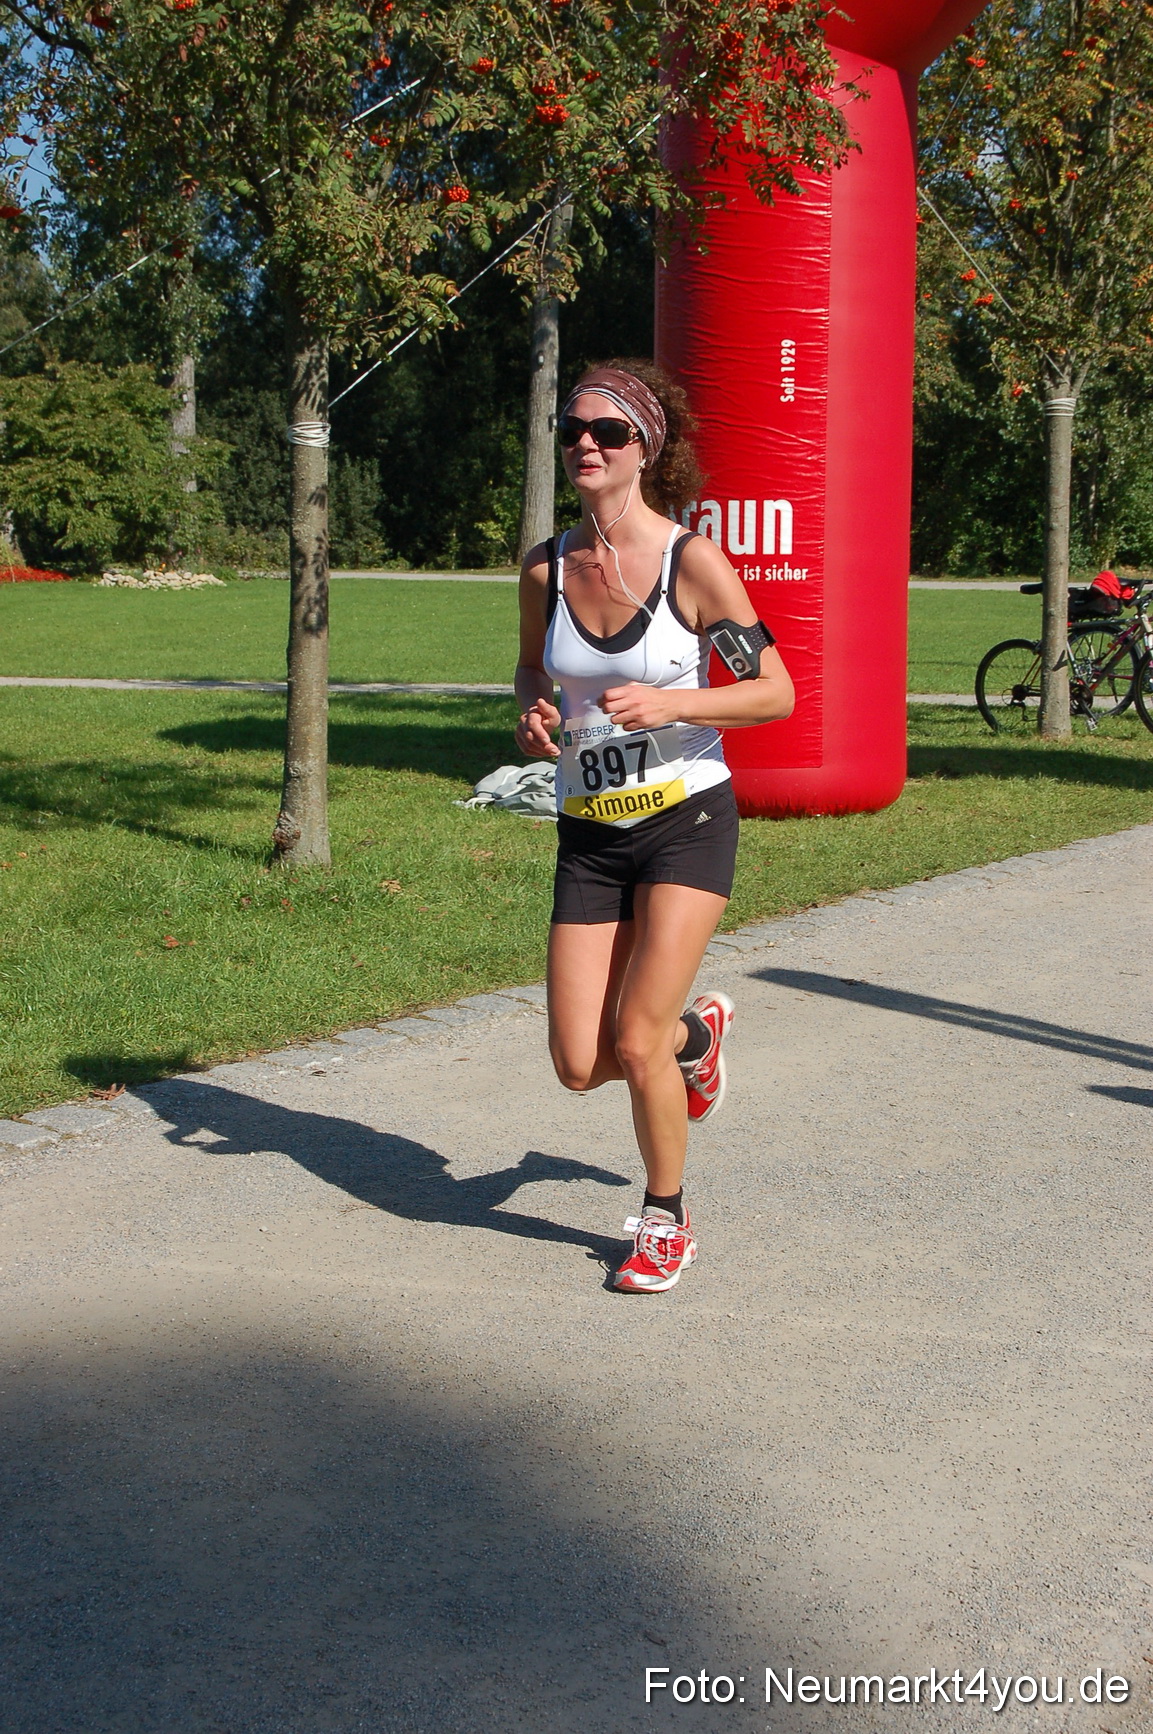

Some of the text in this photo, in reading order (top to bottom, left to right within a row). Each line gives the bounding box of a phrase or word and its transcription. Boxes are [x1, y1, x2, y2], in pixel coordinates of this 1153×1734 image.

[780, 339, 796, 403] Seit 1929
[669, 499, 793, 555] raun
[743, 565, 761, 581] ist
[765, 562, 808, 581] sicher
[579, 739, 649, 792] 897
[584, 790, 664, 819] Simone
